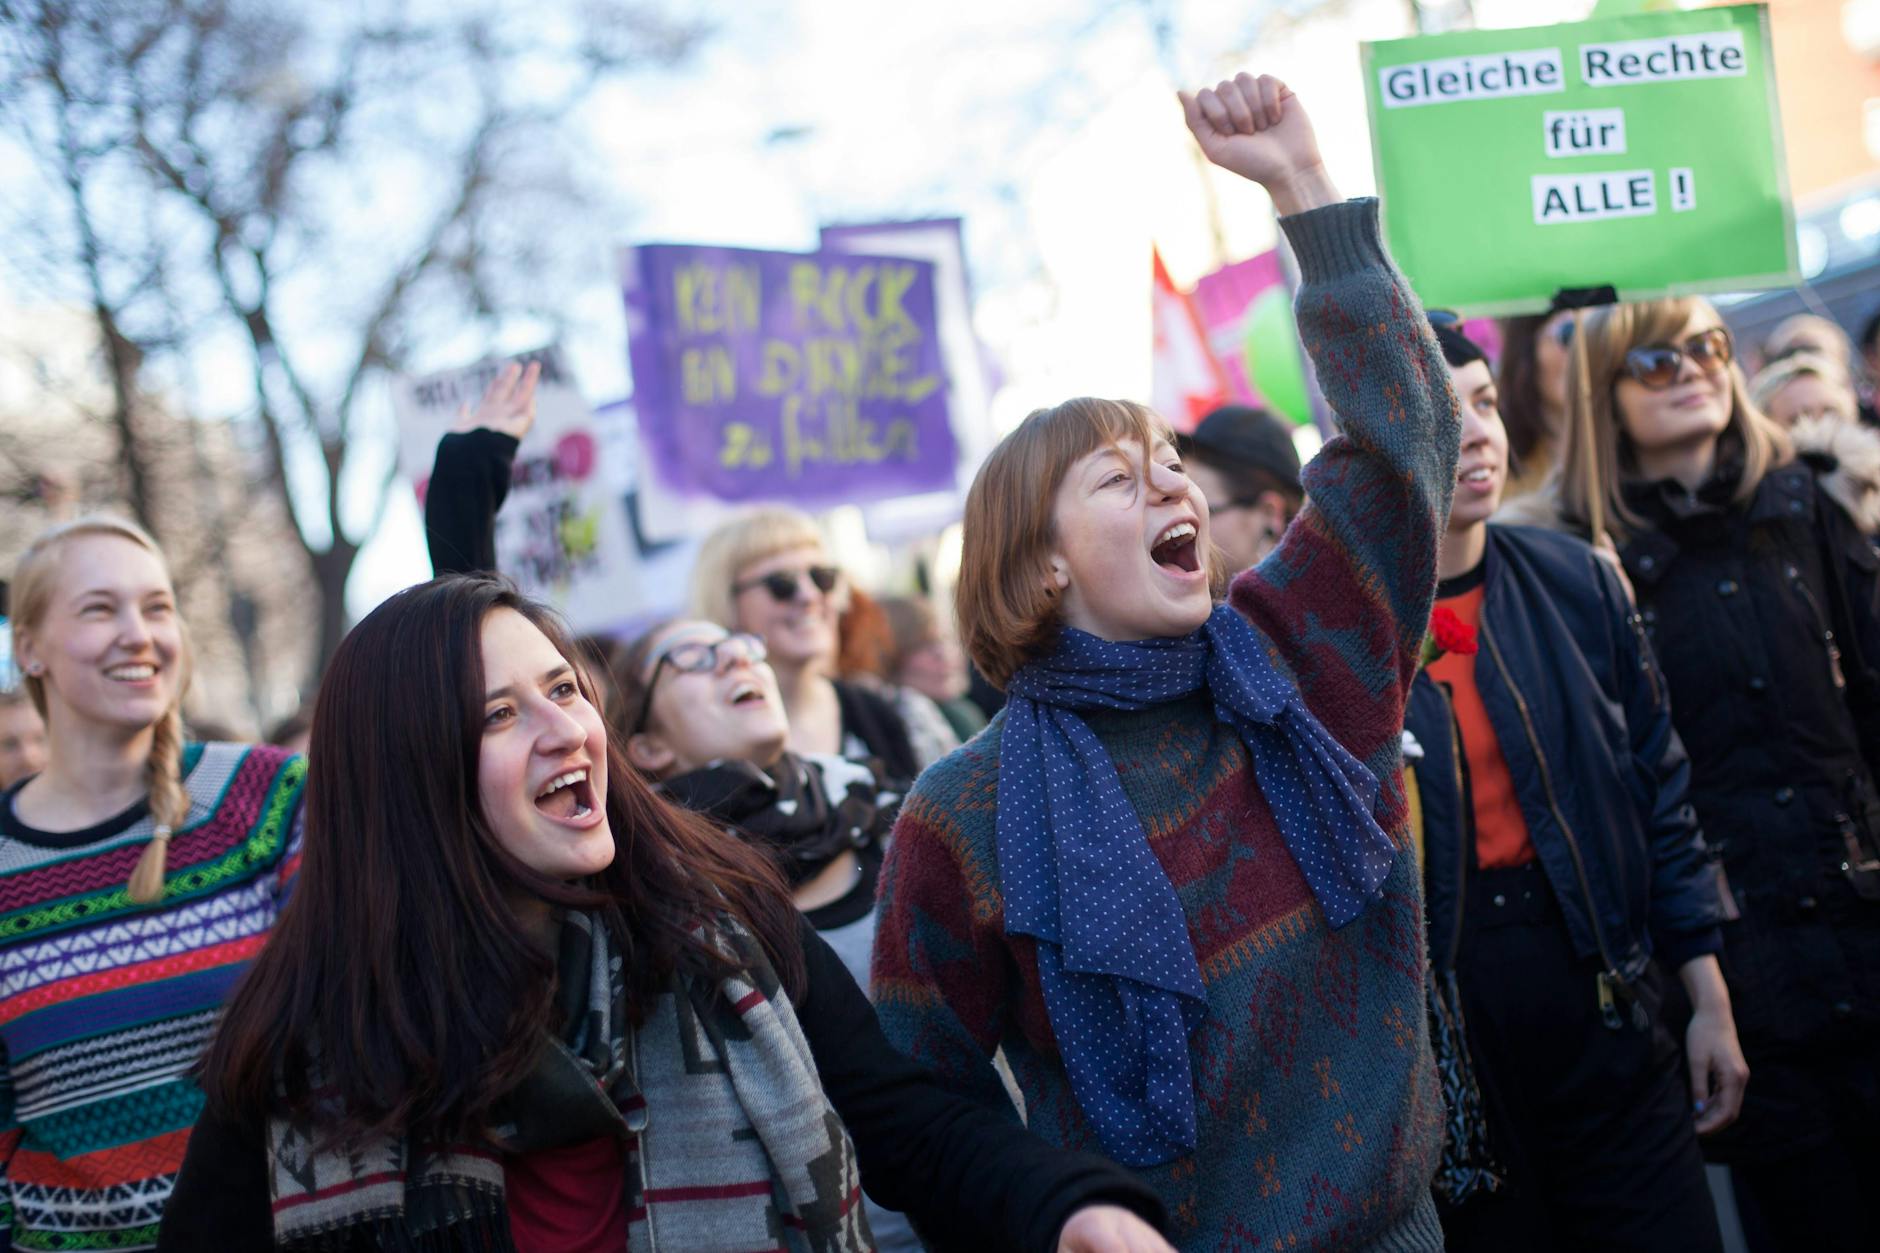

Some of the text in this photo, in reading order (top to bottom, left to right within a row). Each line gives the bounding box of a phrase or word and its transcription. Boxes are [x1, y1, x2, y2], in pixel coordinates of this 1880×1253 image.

[1387, 42, 1744, 102] Gleiche Rechte
[1550, 116, 1617, 152] für
[1542, 174, 1689, 218] ALLE !
